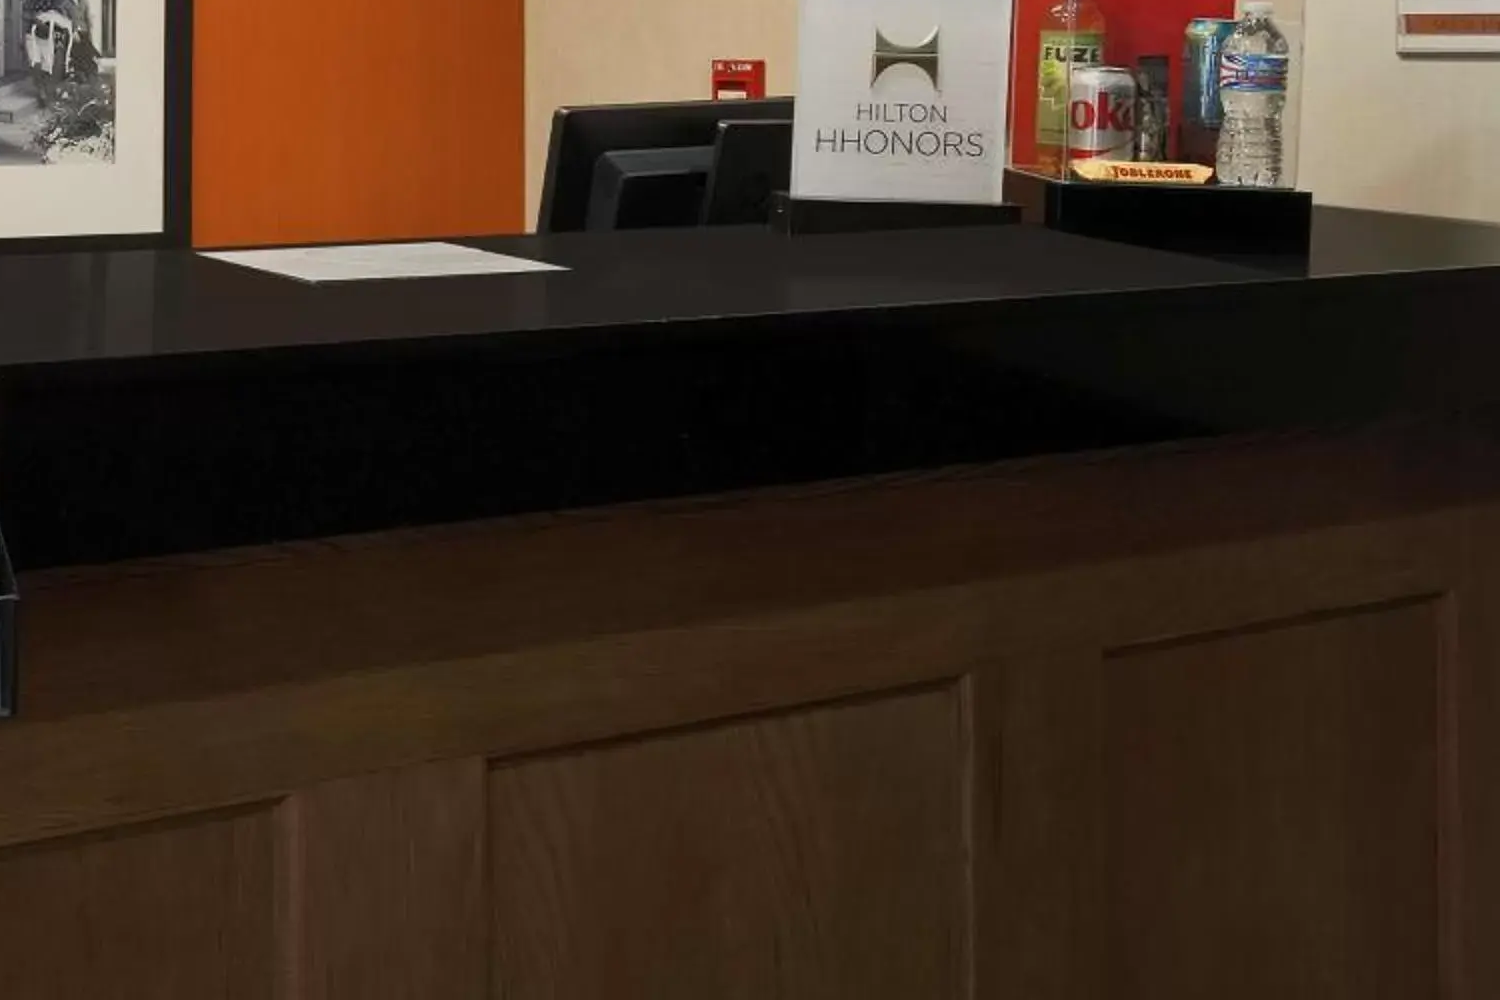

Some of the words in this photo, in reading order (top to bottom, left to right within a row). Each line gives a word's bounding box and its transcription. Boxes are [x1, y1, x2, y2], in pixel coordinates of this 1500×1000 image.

[1043, 46, 1101, 63] FUZE
[856, 102, 948, 125] HILTON
[815, 128, 984, 159] HHONORS
[1111, 165, 1193, 179] TOBLERONE
